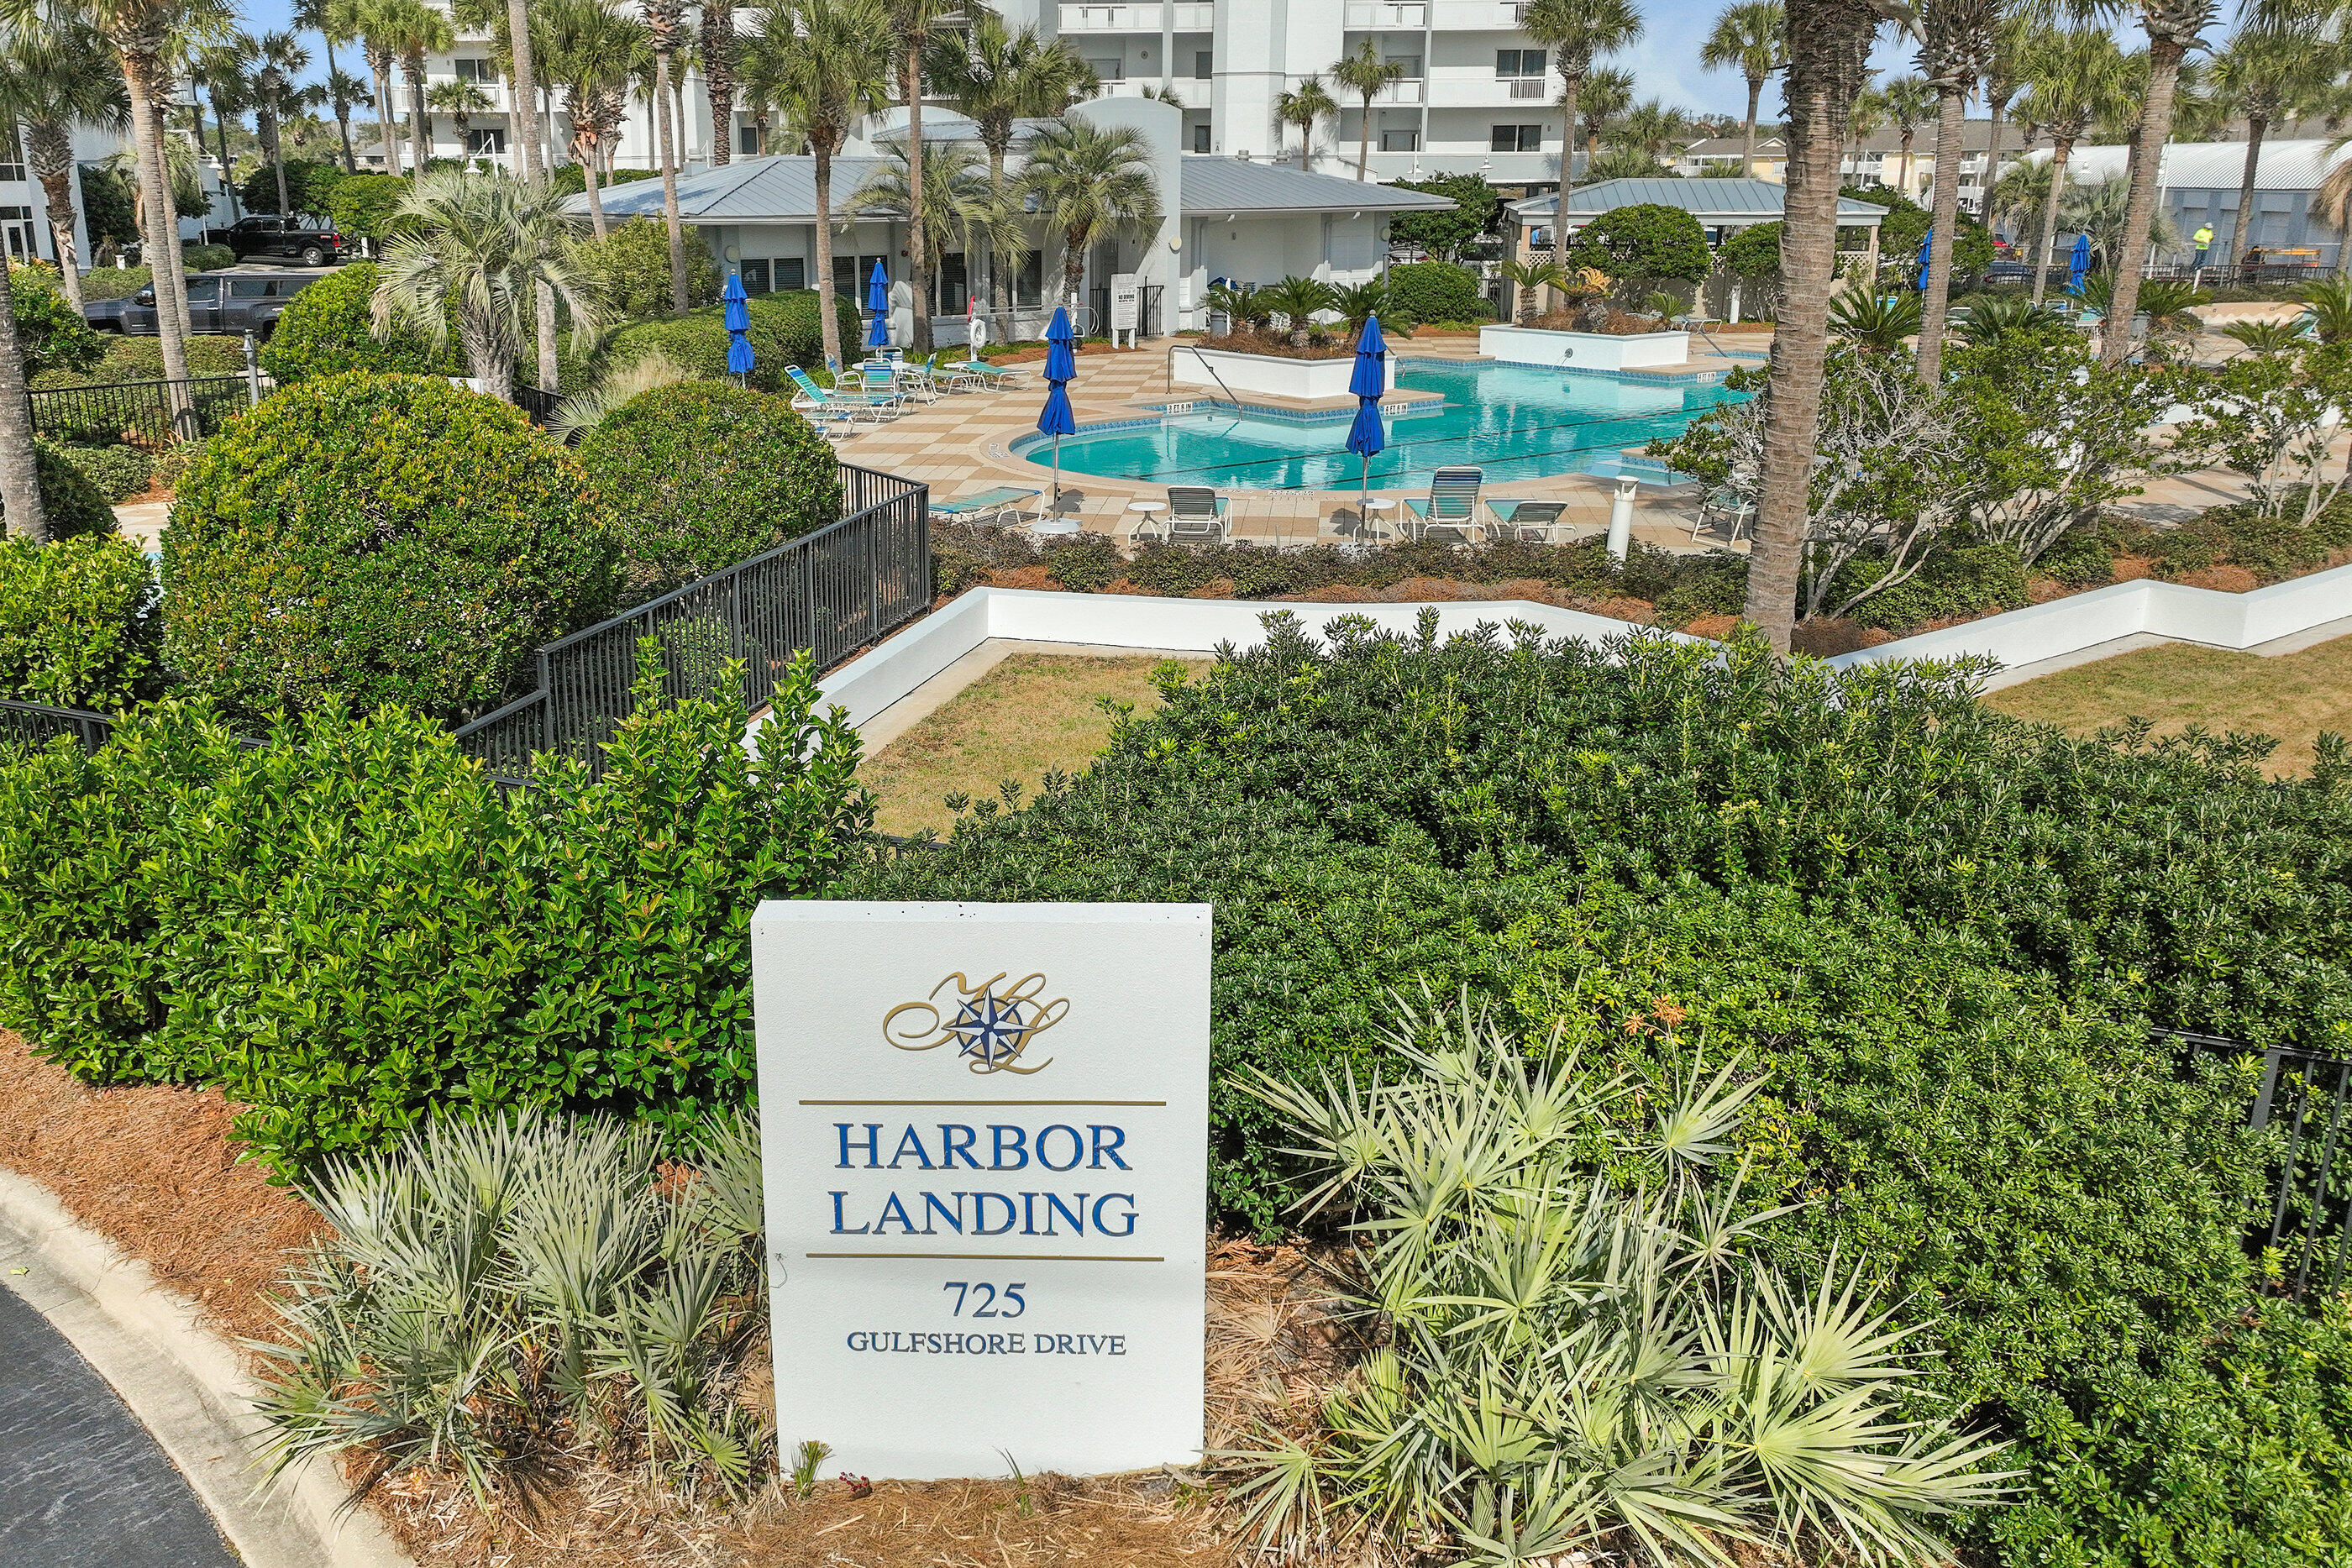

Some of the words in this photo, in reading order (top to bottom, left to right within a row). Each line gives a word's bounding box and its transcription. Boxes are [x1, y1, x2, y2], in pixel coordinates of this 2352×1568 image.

[832, 1123, 1133, 1172] HARBOR
[827, 1191, 1139, 1237] LANDING
[943, 1282, 1026, 1318] 725
[847, 1331, 1026, 1356] GULFSHORE
[1034, 1333, 1126, 1356] DRIVE
